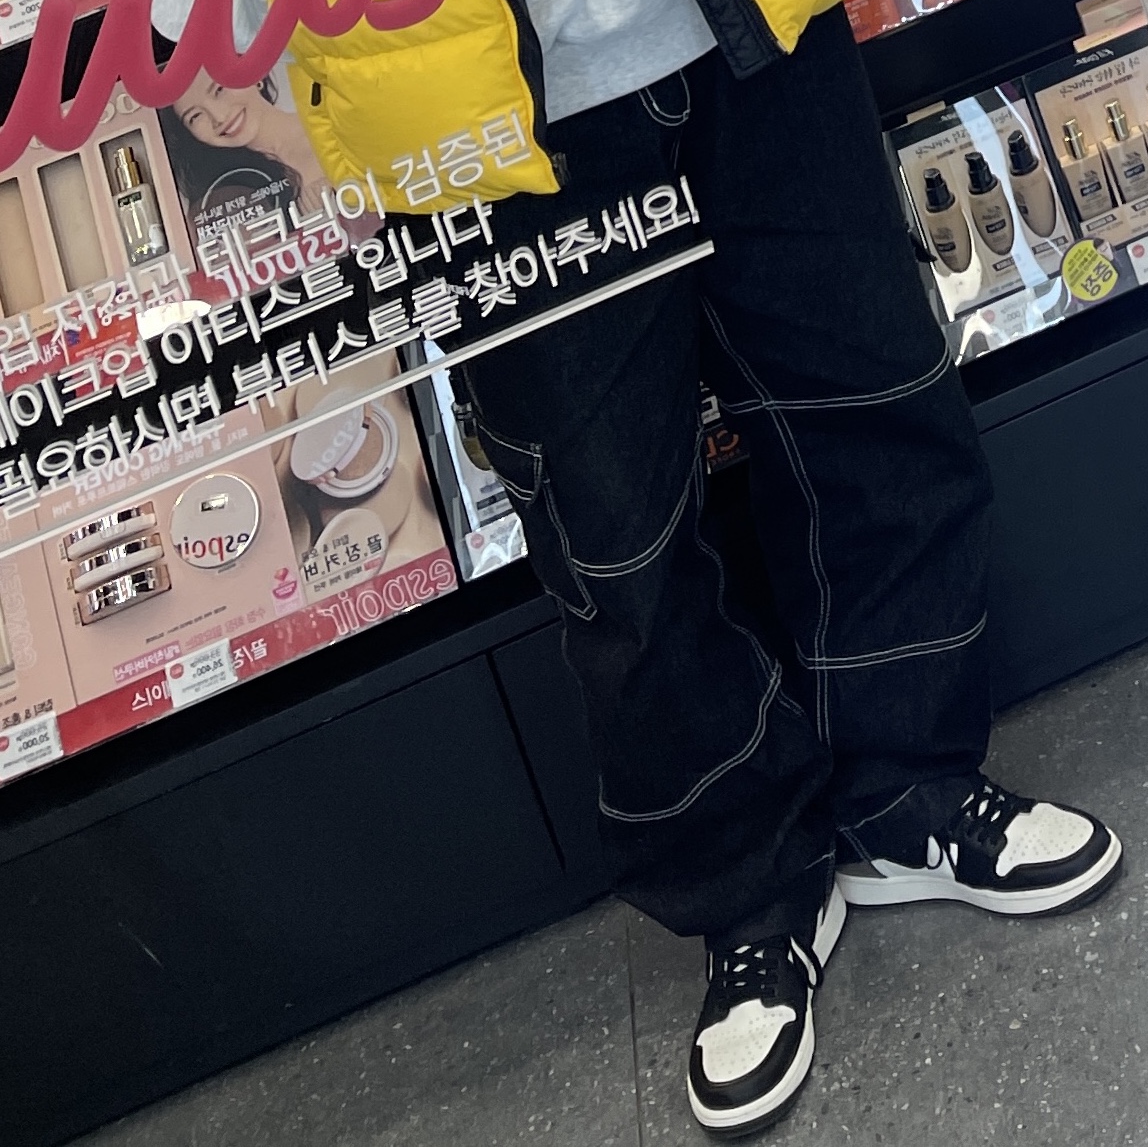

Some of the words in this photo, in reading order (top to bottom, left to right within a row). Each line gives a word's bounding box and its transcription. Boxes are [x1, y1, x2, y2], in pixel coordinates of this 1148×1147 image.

[43, 253, 192, 340] 자격과
[196, 168, 385, 284] 테크닉이
[391, 109, 532, 207] 검증된
[161, 260, 355, 364] 아티스트
[355, 195, 493, 293] 입니다
[233, 277, 462, 414] 뷰티스트를
